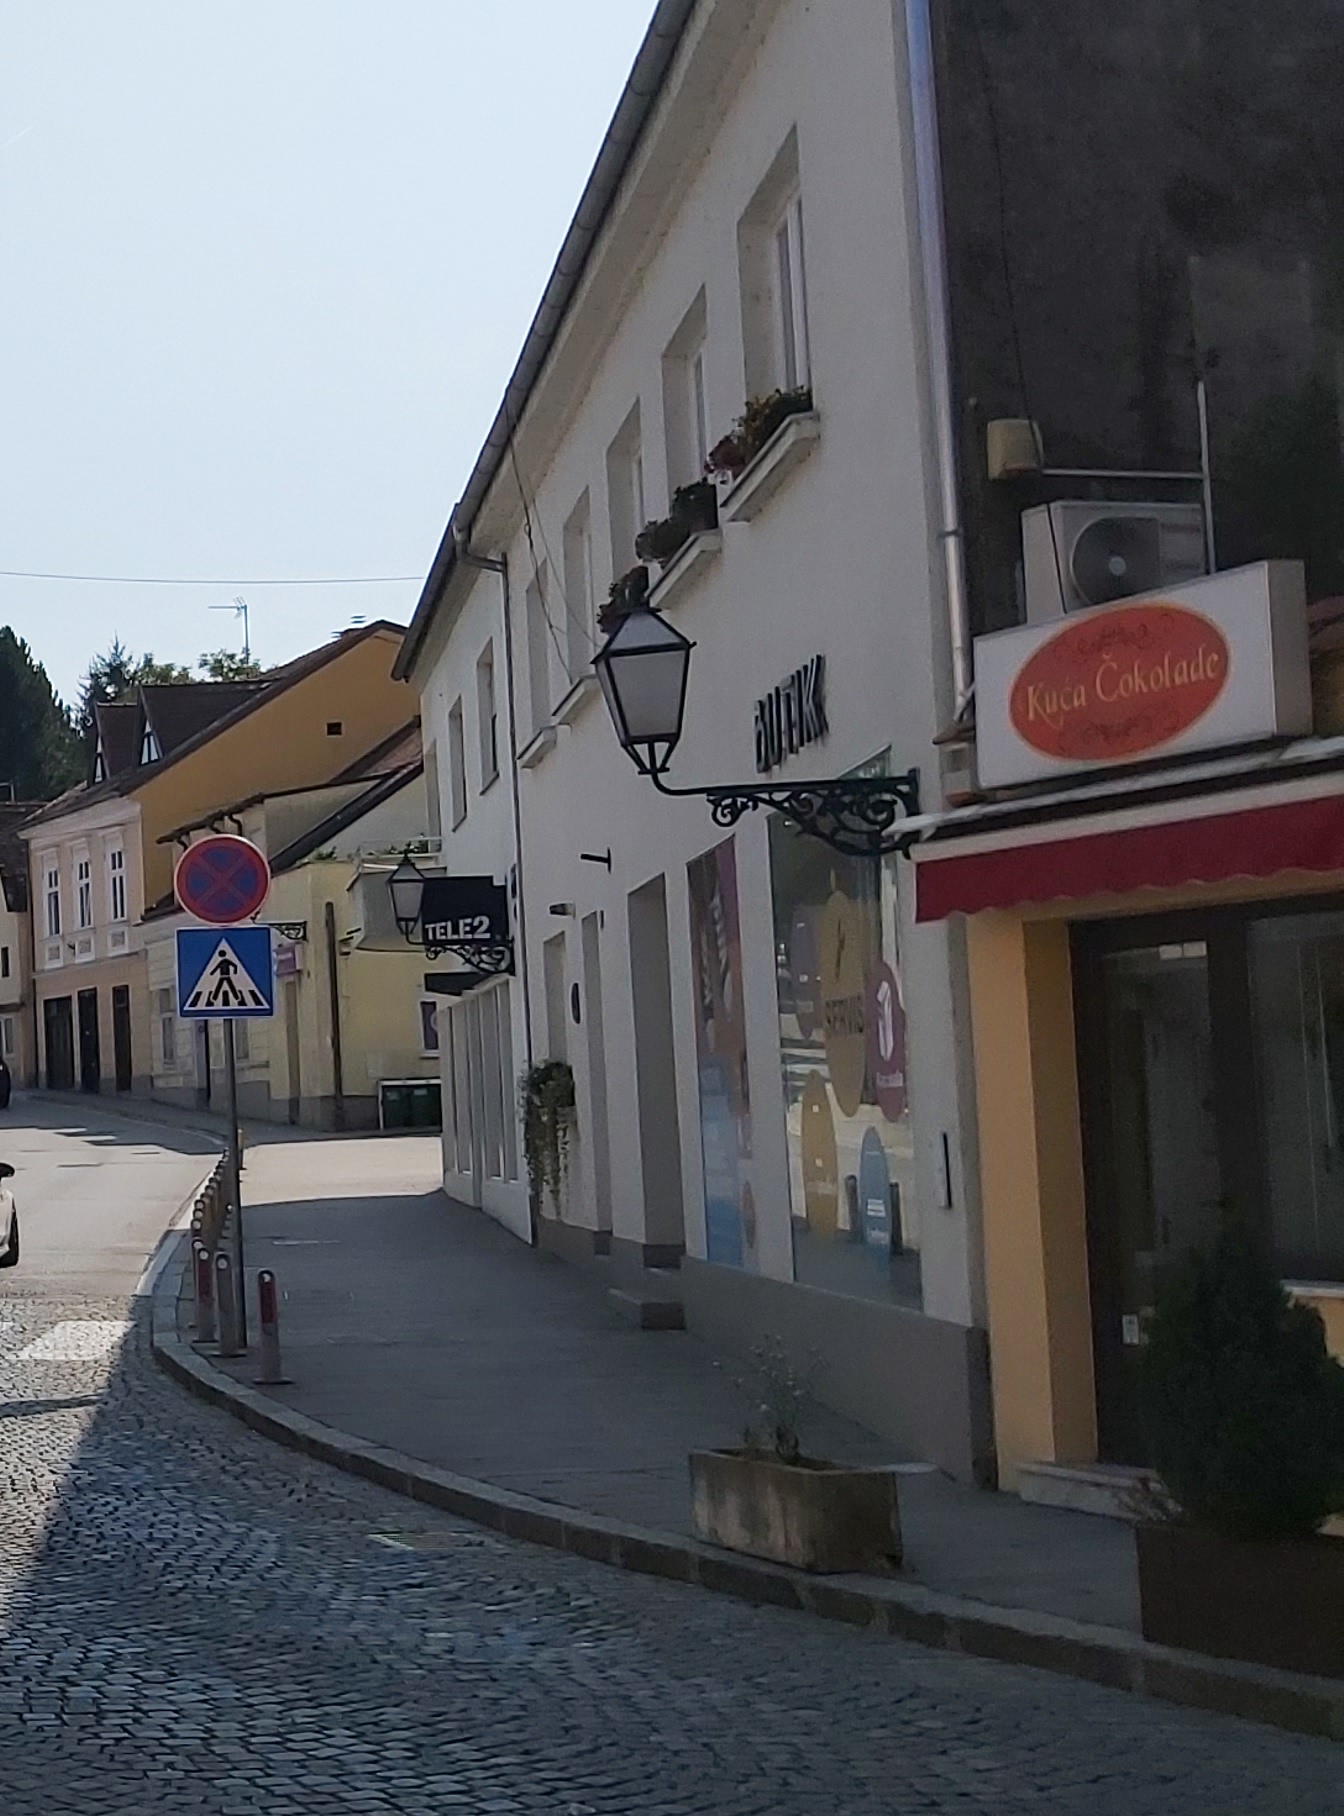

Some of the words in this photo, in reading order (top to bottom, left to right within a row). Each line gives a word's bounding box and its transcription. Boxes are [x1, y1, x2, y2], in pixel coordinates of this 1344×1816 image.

[1027, 678, 1086, 728] Kuća
[1096, 643, 1219, 702] Čokolade
[425, 915, 491, 940] TELE2
